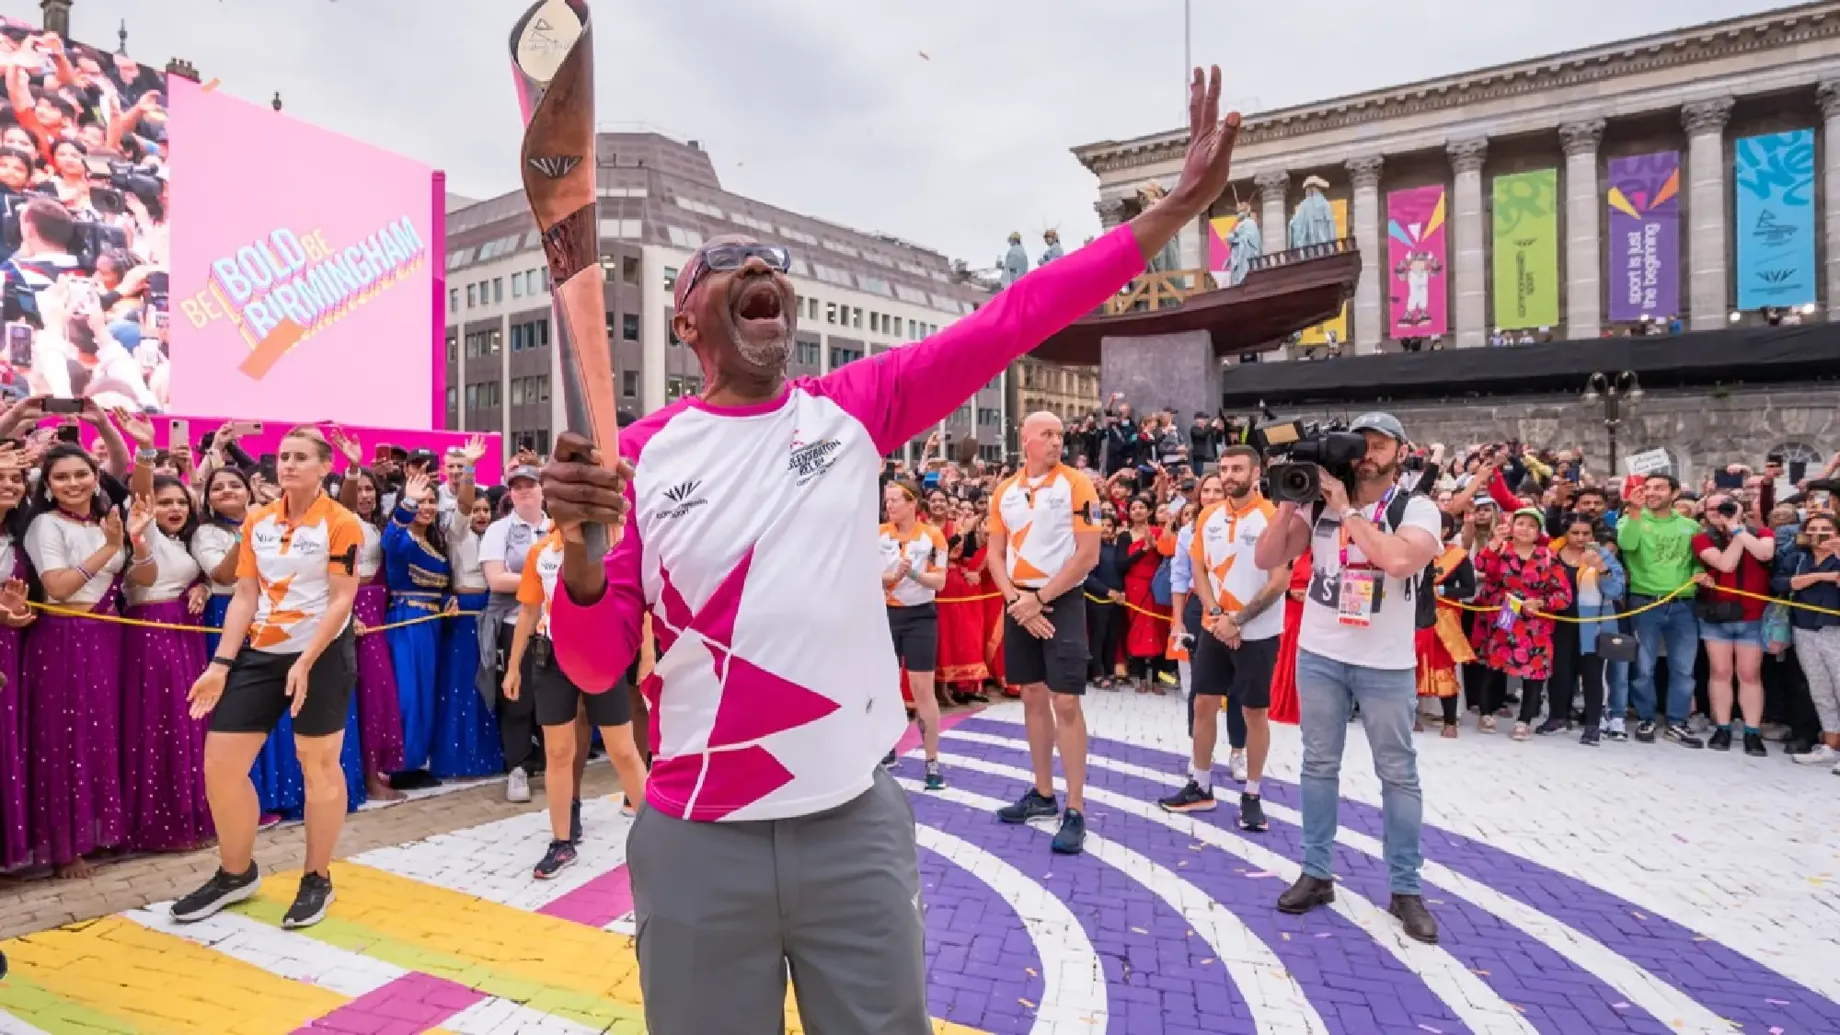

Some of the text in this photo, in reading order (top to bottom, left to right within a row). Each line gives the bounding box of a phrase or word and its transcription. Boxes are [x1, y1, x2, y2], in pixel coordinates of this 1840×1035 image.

[180, 226, 336, 329] BE BOLD BE
[242, 214, 425, 339] BIRMINGHAM
[1627, 231, 1644, 305] sport is just
[1643, 222, 1662, 310] the beginning
